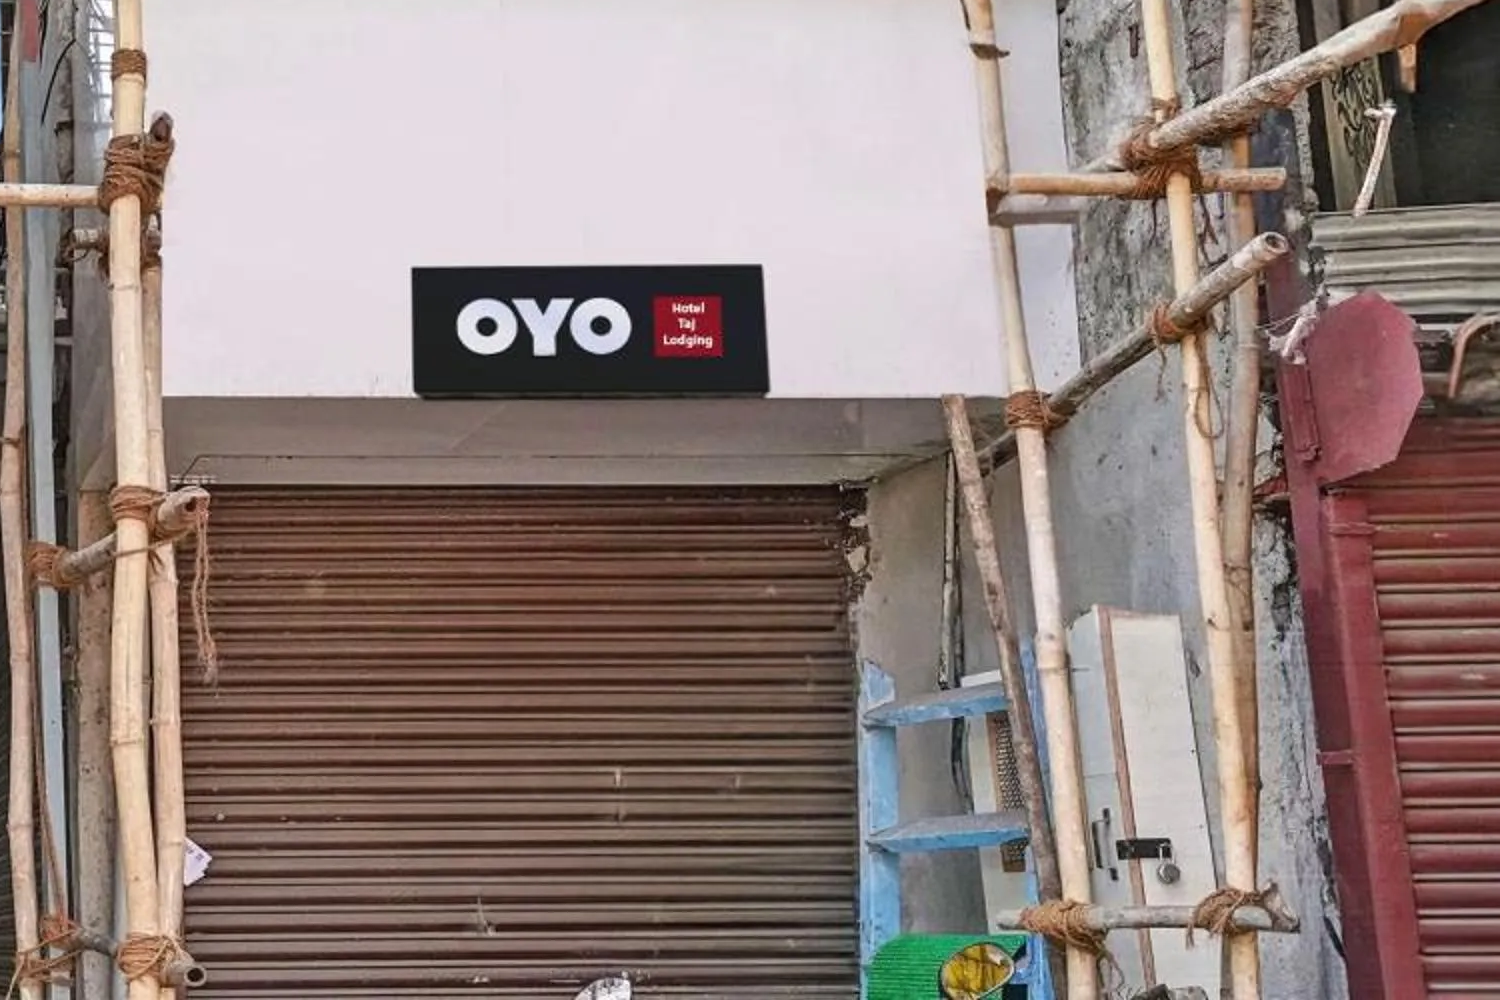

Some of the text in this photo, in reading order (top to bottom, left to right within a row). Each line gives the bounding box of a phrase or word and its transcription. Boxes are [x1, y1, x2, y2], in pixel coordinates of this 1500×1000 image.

[671, 301, 705, 313] Hotel
[456, 297, 632, 356] OYO
[678, 317, 696, 332] Taj
[663, 333, 713, 348] Lodging
